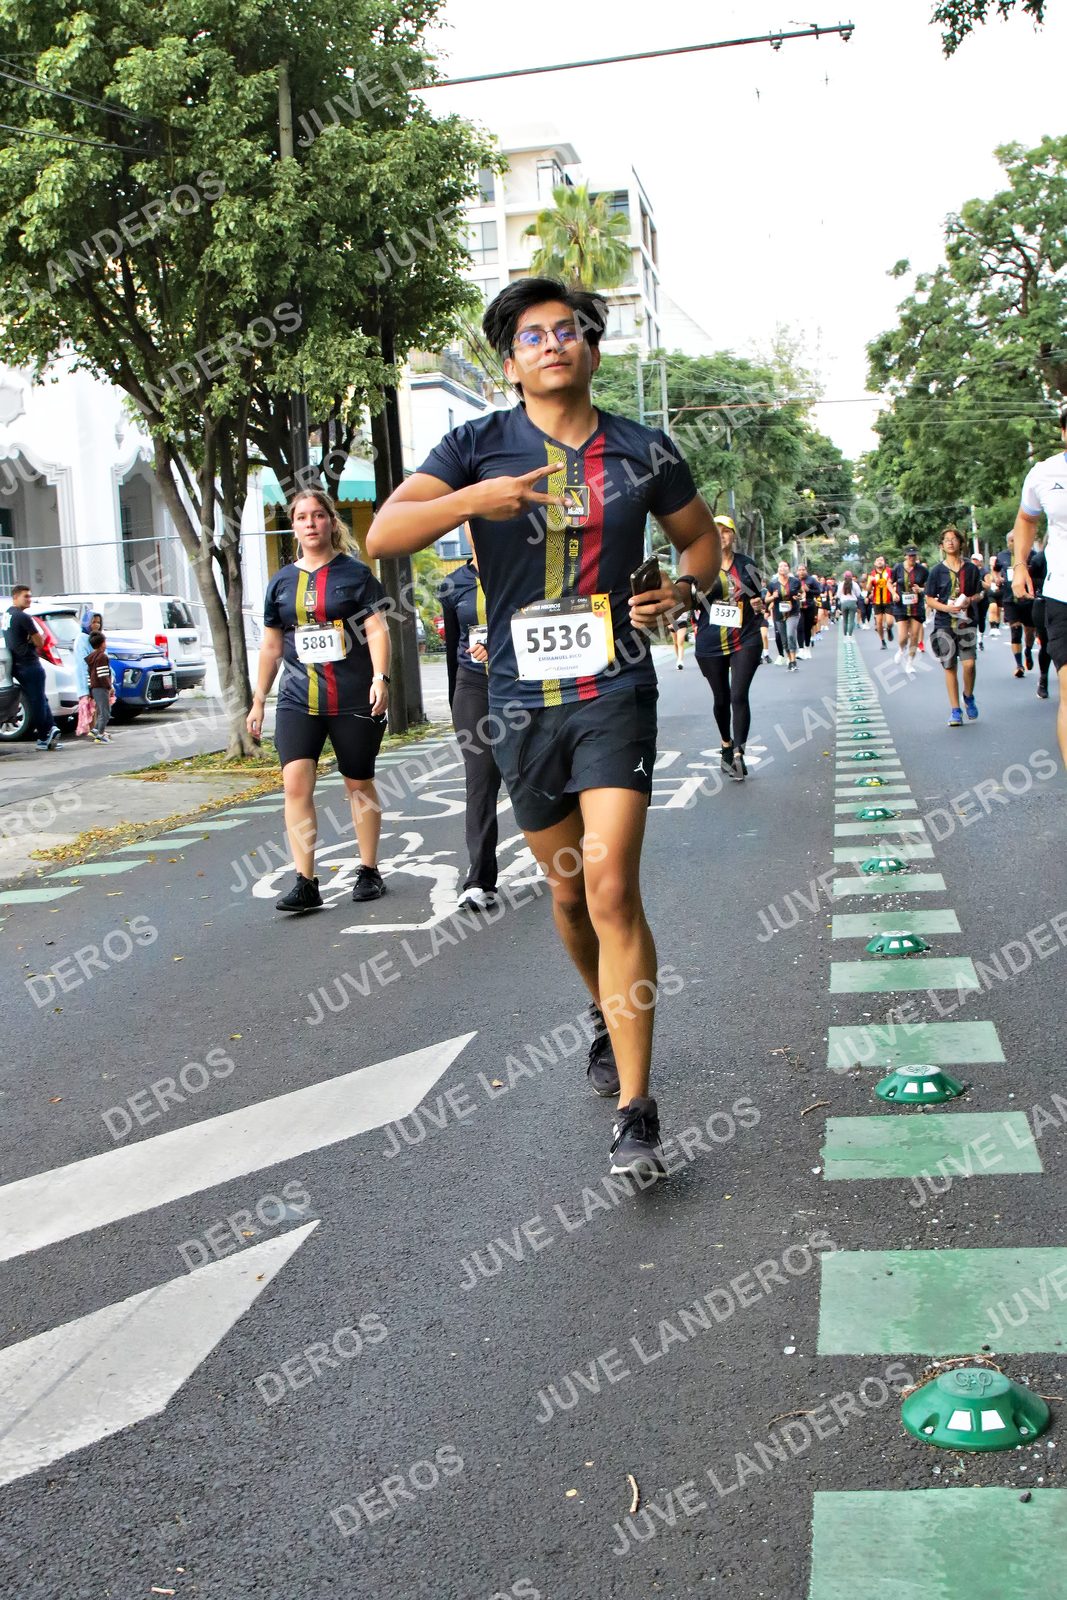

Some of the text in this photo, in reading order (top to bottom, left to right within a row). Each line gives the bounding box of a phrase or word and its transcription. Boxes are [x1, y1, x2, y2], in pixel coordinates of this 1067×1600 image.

[594, 601, 607, 610] 5K
[714, 608, 737, 618] 3537
[302, 635, 334, 650] 5881
[527, 623, 592, 653] 5536
